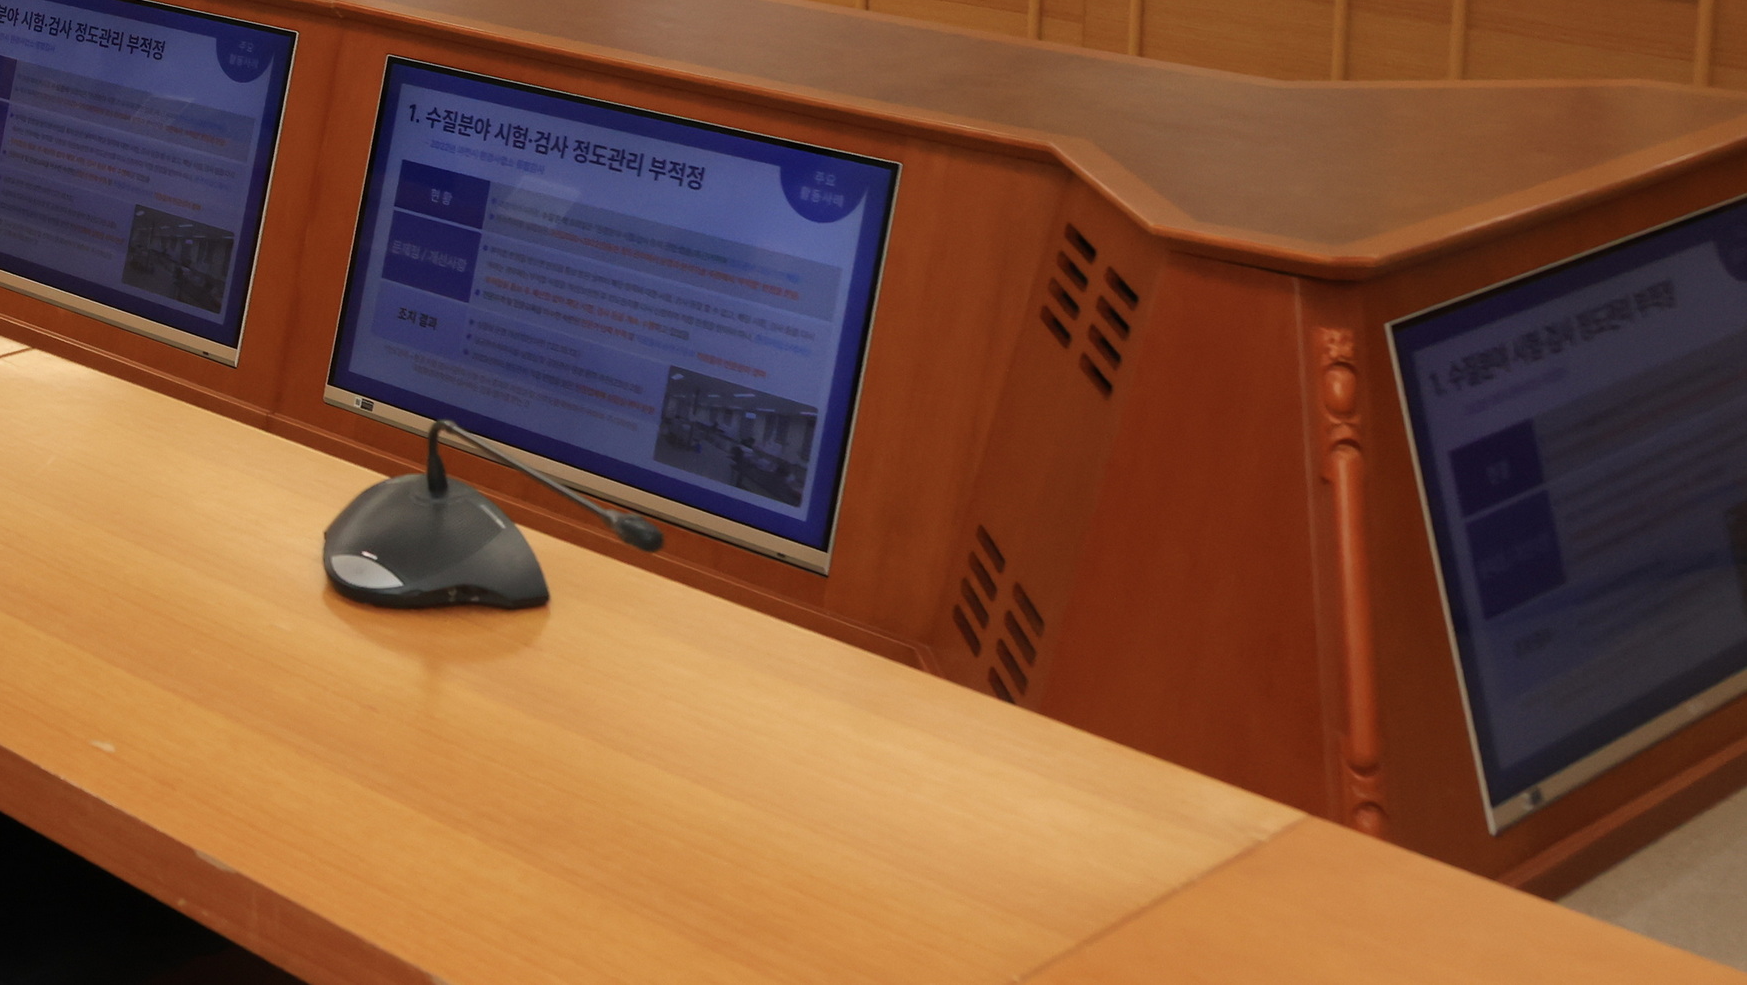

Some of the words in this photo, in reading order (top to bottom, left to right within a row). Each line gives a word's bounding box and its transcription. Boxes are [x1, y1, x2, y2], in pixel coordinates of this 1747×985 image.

[74, 22, 125, 52] 정도관리
[126, 34, 167, 61] 부적정
[408, 103, 420, 124] 1.
[425, 106, 492, 142] 수질분야
[572, 139, 645, 178] 정도관리
[648, 156, 706, 191] 부적정
